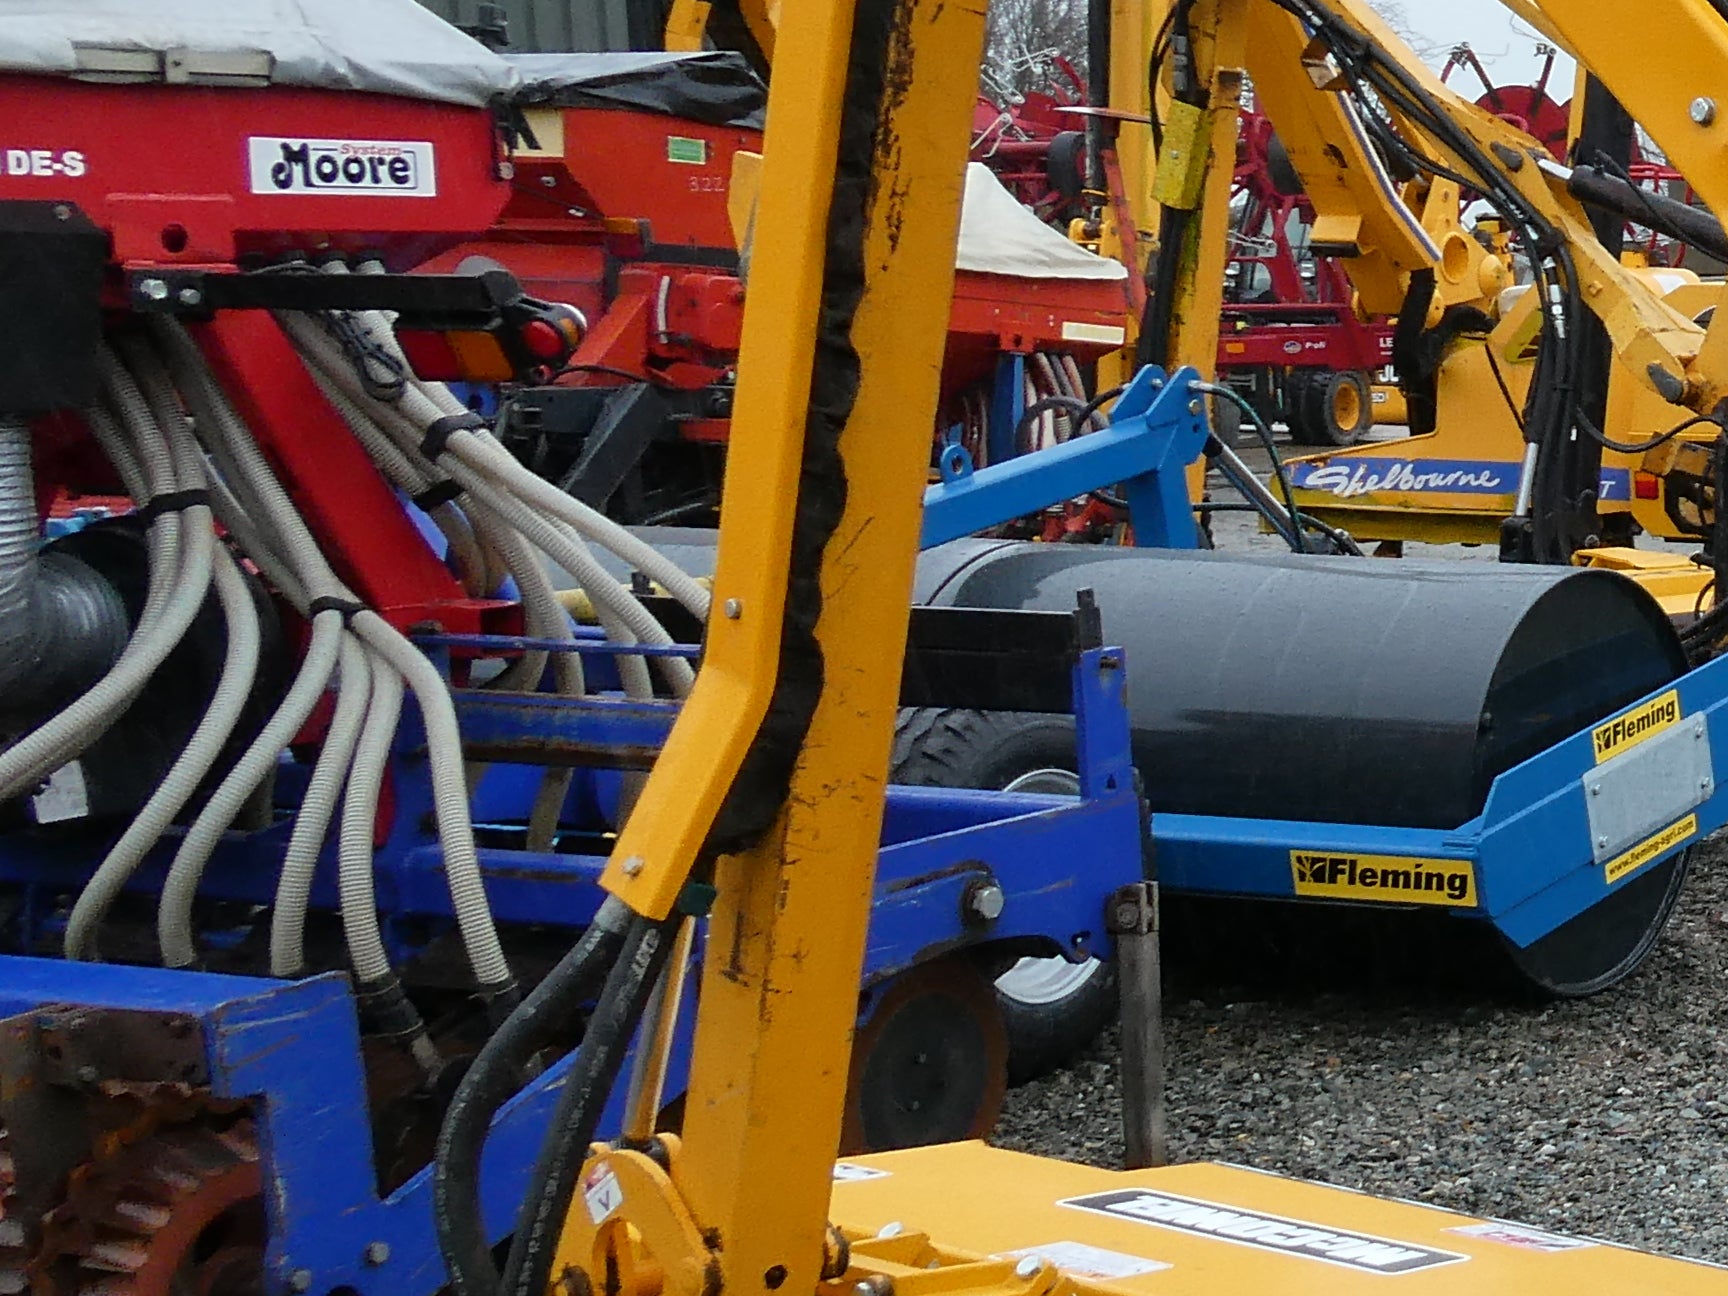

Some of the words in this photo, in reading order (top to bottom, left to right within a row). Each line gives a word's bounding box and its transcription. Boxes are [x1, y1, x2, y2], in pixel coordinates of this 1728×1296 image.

[6, 150, 85, 177] DE-S
[271, 142, 410, 190] Moore
[1305, 464, 1501, 499] Shelbourne
[1611, 699, 1676, 746] Fleming
[1327, 857, 1468, 900] Fleming
